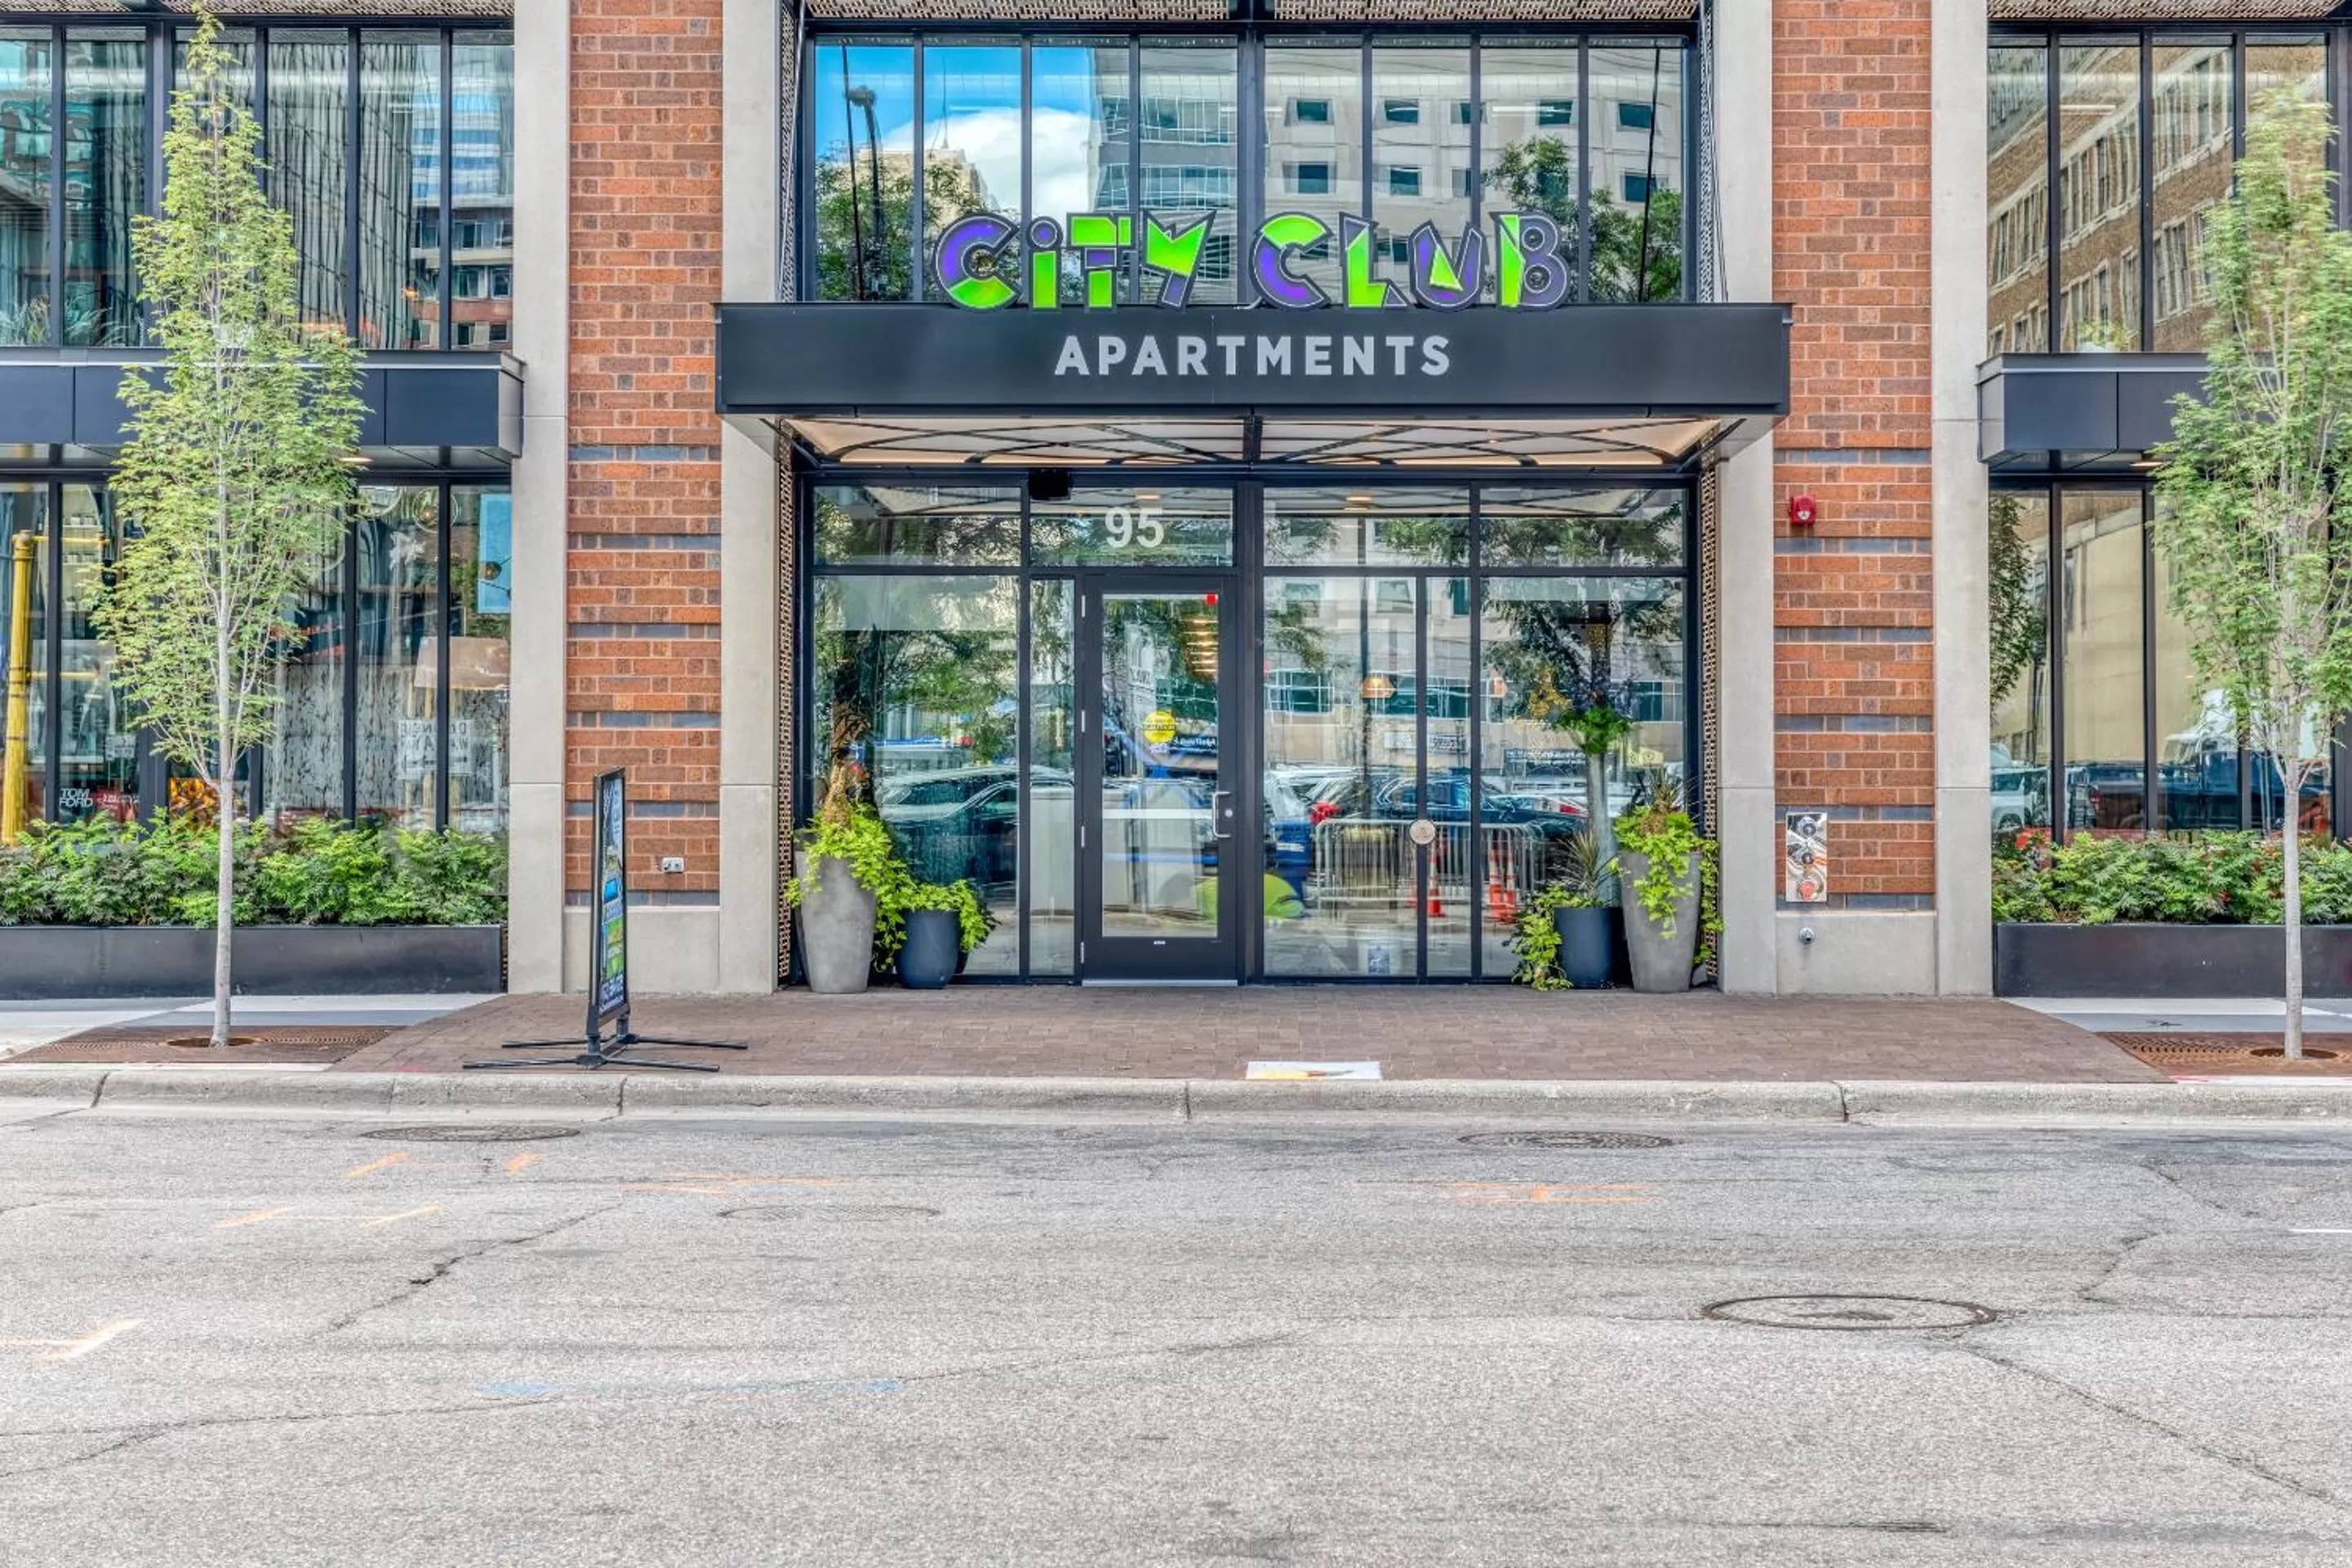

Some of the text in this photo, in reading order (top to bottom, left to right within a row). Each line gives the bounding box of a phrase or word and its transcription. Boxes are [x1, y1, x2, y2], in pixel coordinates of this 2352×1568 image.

[1248, 211, 1571, 313] CLUB
[1055, 335, 1452, 377] APARTMENTS
[1105, 506, 1164, 549] 95
[60, 788, 90, 798] TOM
[60, 797, 93, 807] FORD
